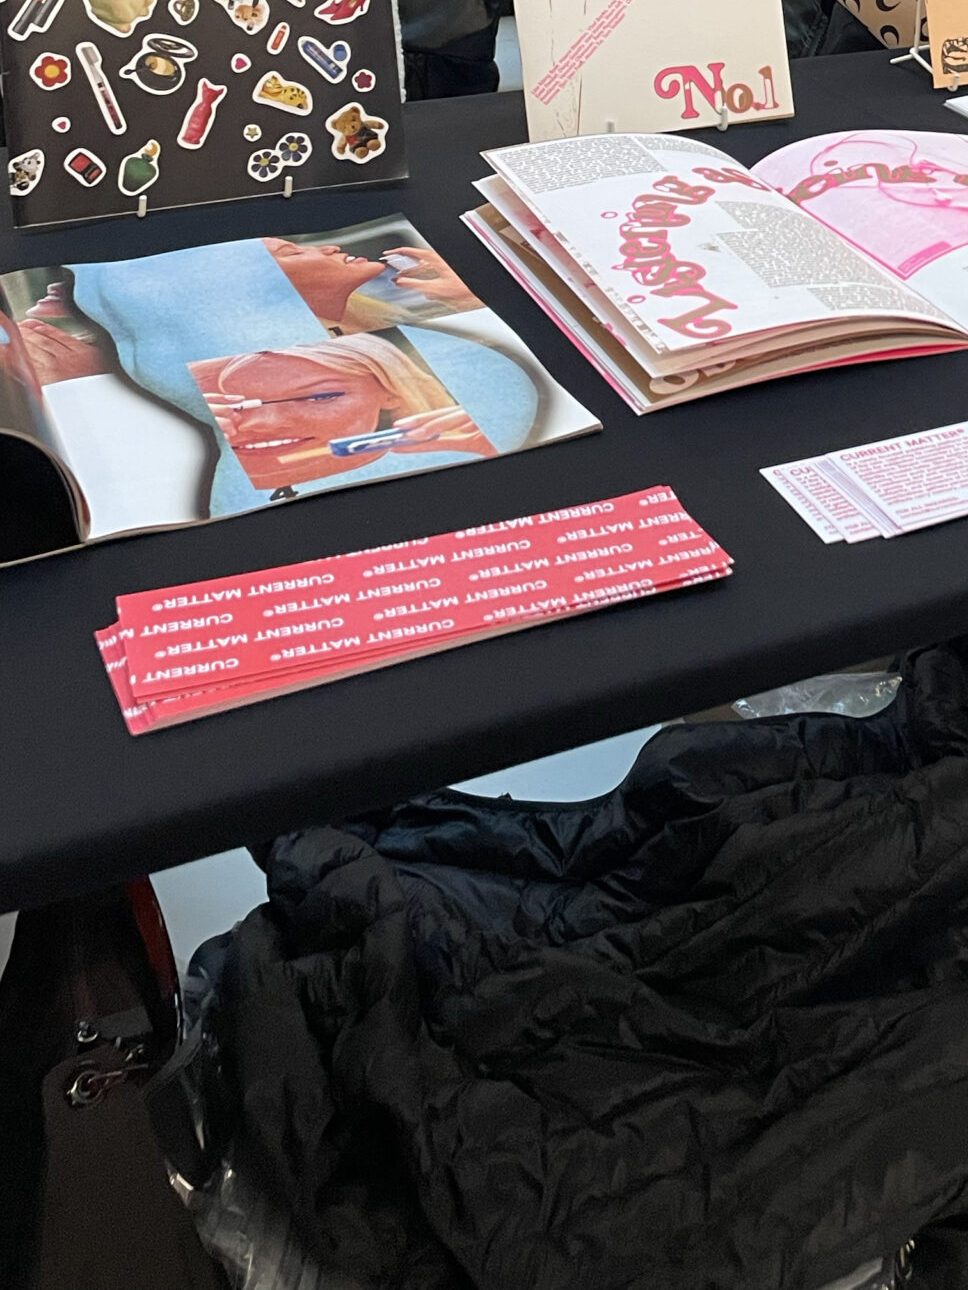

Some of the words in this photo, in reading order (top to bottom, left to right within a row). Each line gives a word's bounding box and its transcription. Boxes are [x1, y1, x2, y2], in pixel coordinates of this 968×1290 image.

[840, 442, 903, 462] CURRENT
[538, 502, 615, 526] CURRENT
[450, 539, 531, 563] CURRENT
[554, 542, 633, 566] CURRENT
[247, 573, 335, 597] CURRENT
[356, 577, 441, 602] CURRENT
[463, 579, 547, 605] CURRENT
[139, 613, 234, 638] CURRENT
[253, 615, 344, 642] CURRENT
[366, 617, 456, 645] CURRENT
[143, 657, 239, 684] CURRENT
